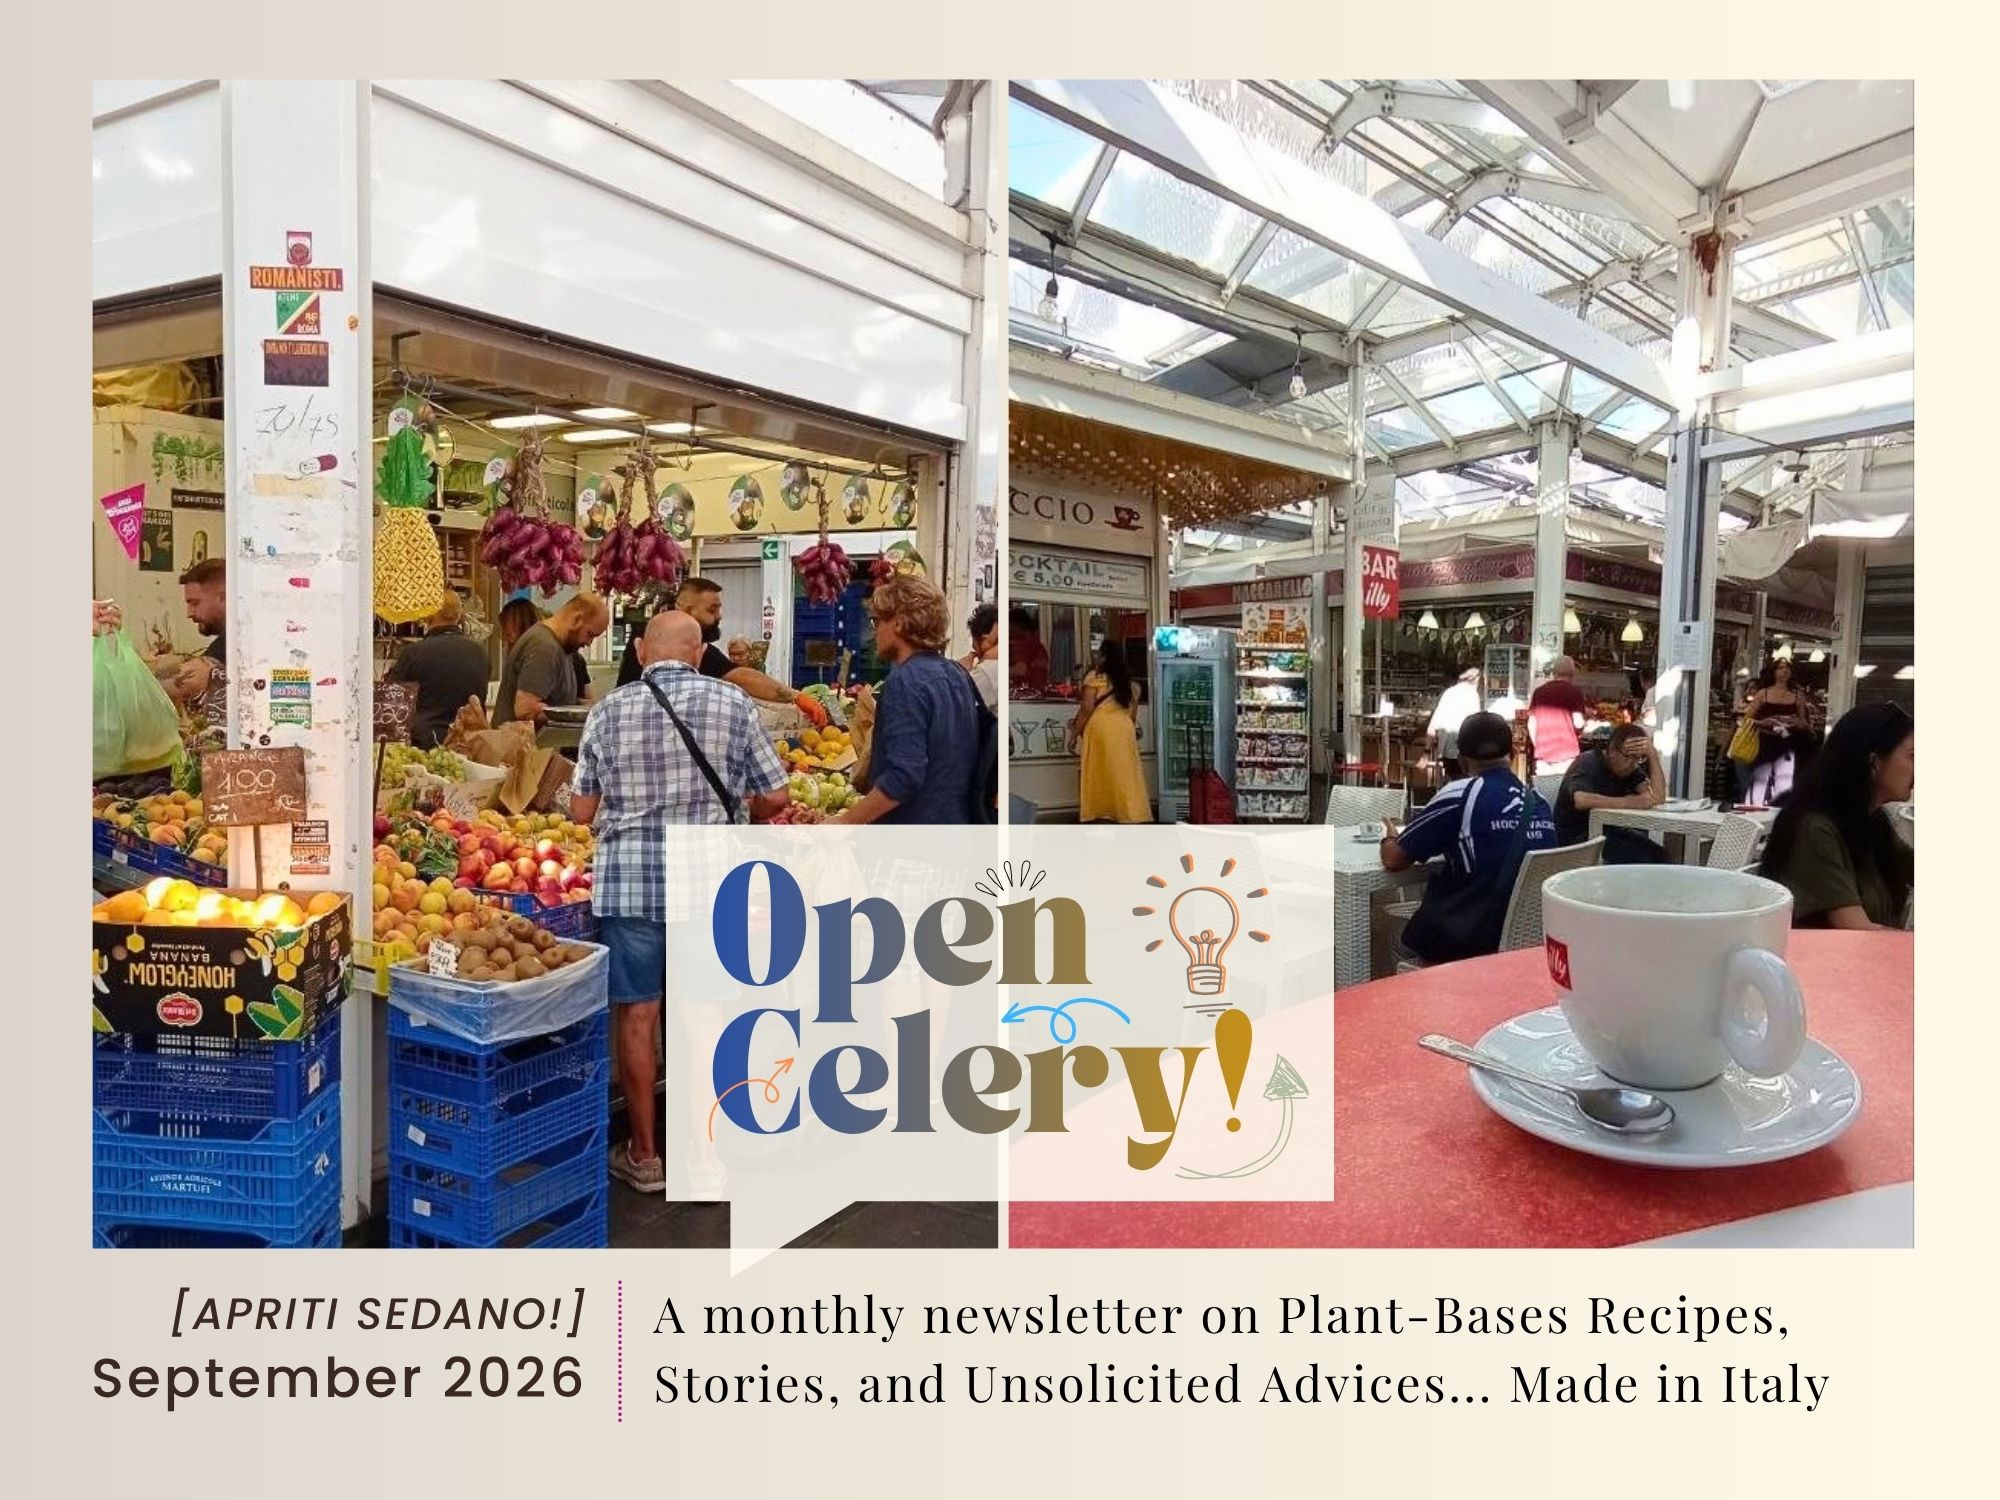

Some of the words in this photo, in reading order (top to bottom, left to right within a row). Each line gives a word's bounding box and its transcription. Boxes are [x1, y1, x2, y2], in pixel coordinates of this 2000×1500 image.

[1009, 485, 1094, 525] CCIO
[1362, 551, 1398, 580] BAR
[1365, 581, 1391, 614] illy
[150, 951, 210, 963] BANANA
[129, 963, 236, 989] HONEYGLOW
[162, 1181, 211, 1194] MARTUFI
